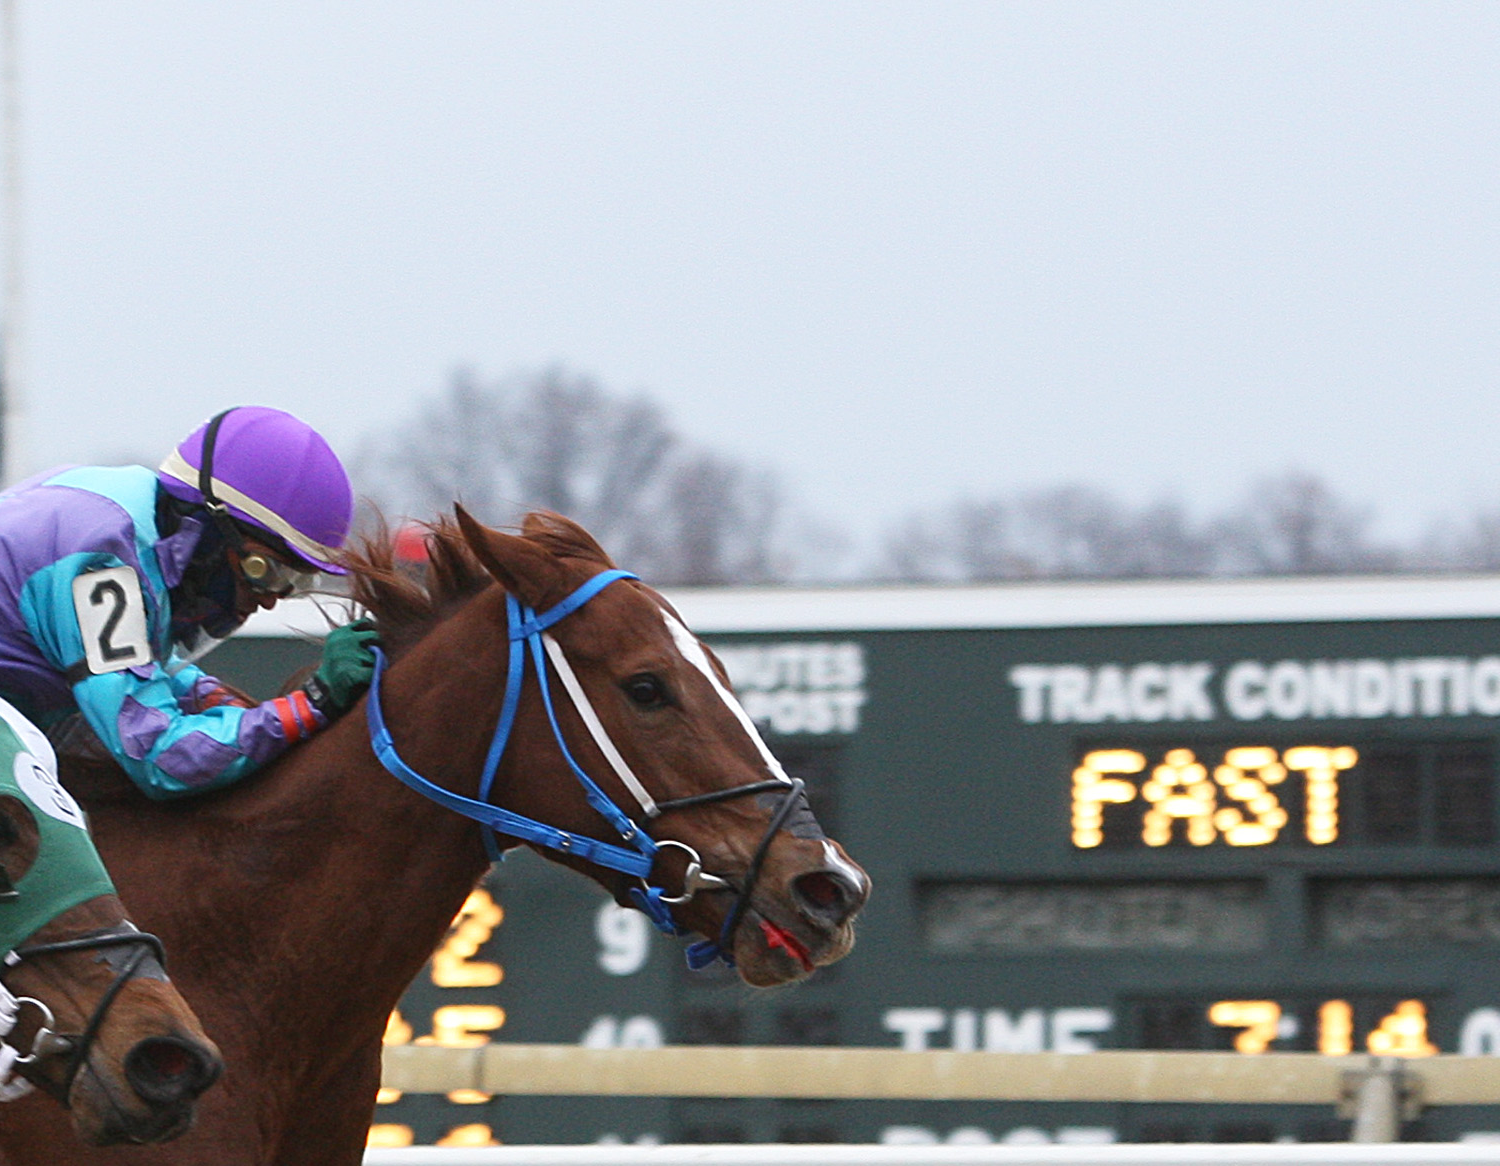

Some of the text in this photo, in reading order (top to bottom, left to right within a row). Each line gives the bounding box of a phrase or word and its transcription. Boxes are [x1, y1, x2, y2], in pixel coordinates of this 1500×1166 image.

[89, 579, 138, 663] 2
[1011, 662, 1213, 724] TRACK
[1071, 746, 1359, 850] FAST
[595, 898, 650, 976] 9
